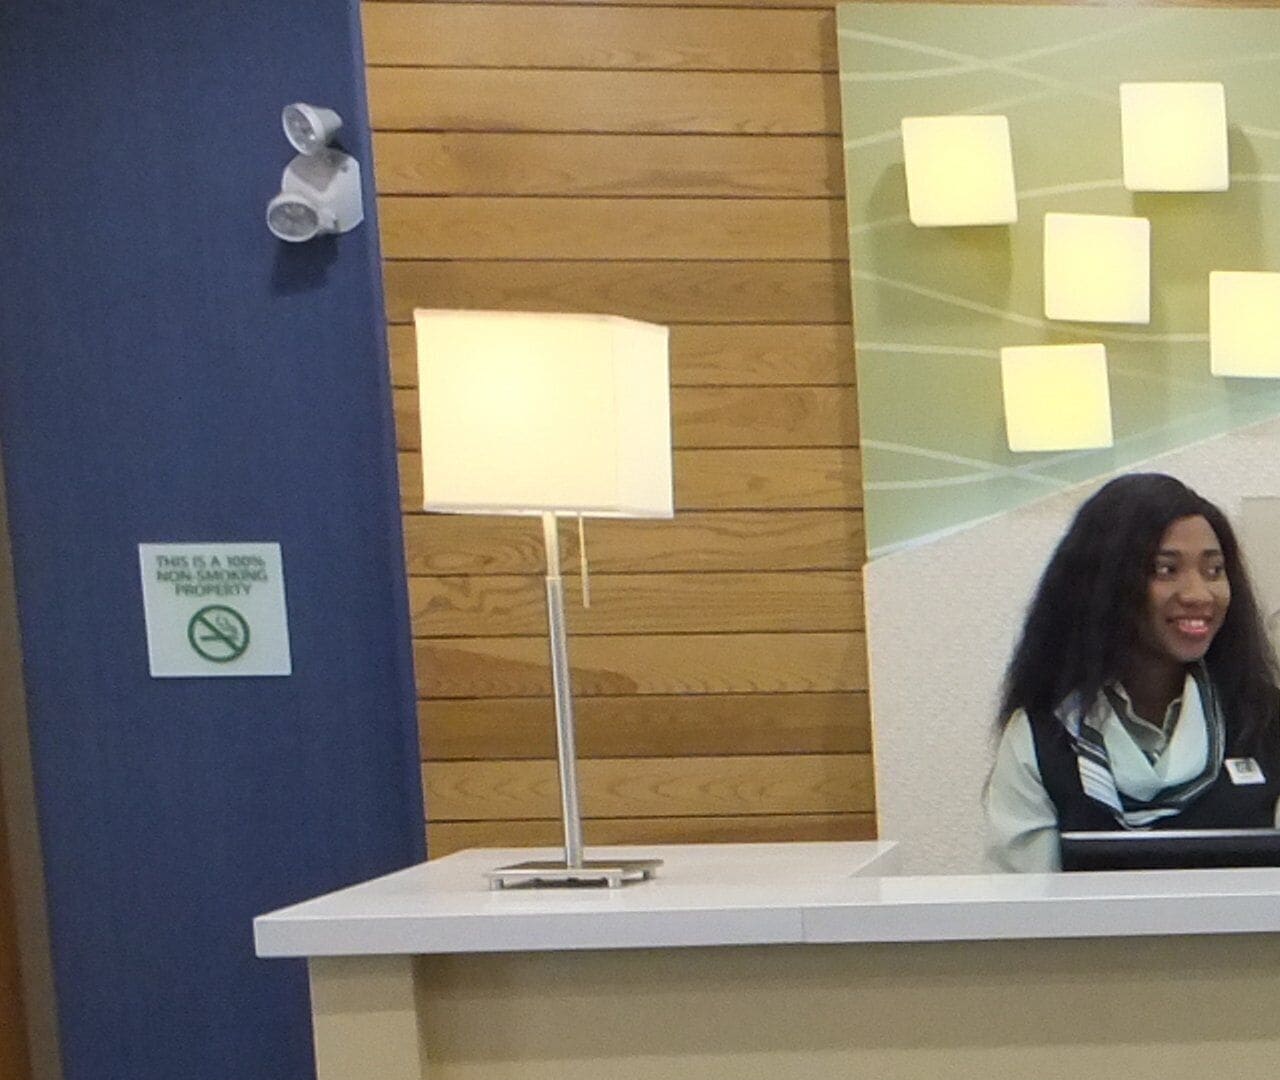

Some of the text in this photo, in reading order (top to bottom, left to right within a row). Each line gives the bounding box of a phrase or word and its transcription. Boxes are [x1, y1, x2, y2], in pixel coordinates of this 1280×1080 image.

[156, 555, 266, 568] THIS IS A 100%
[175, 584, 252, 596] PROPERTY
